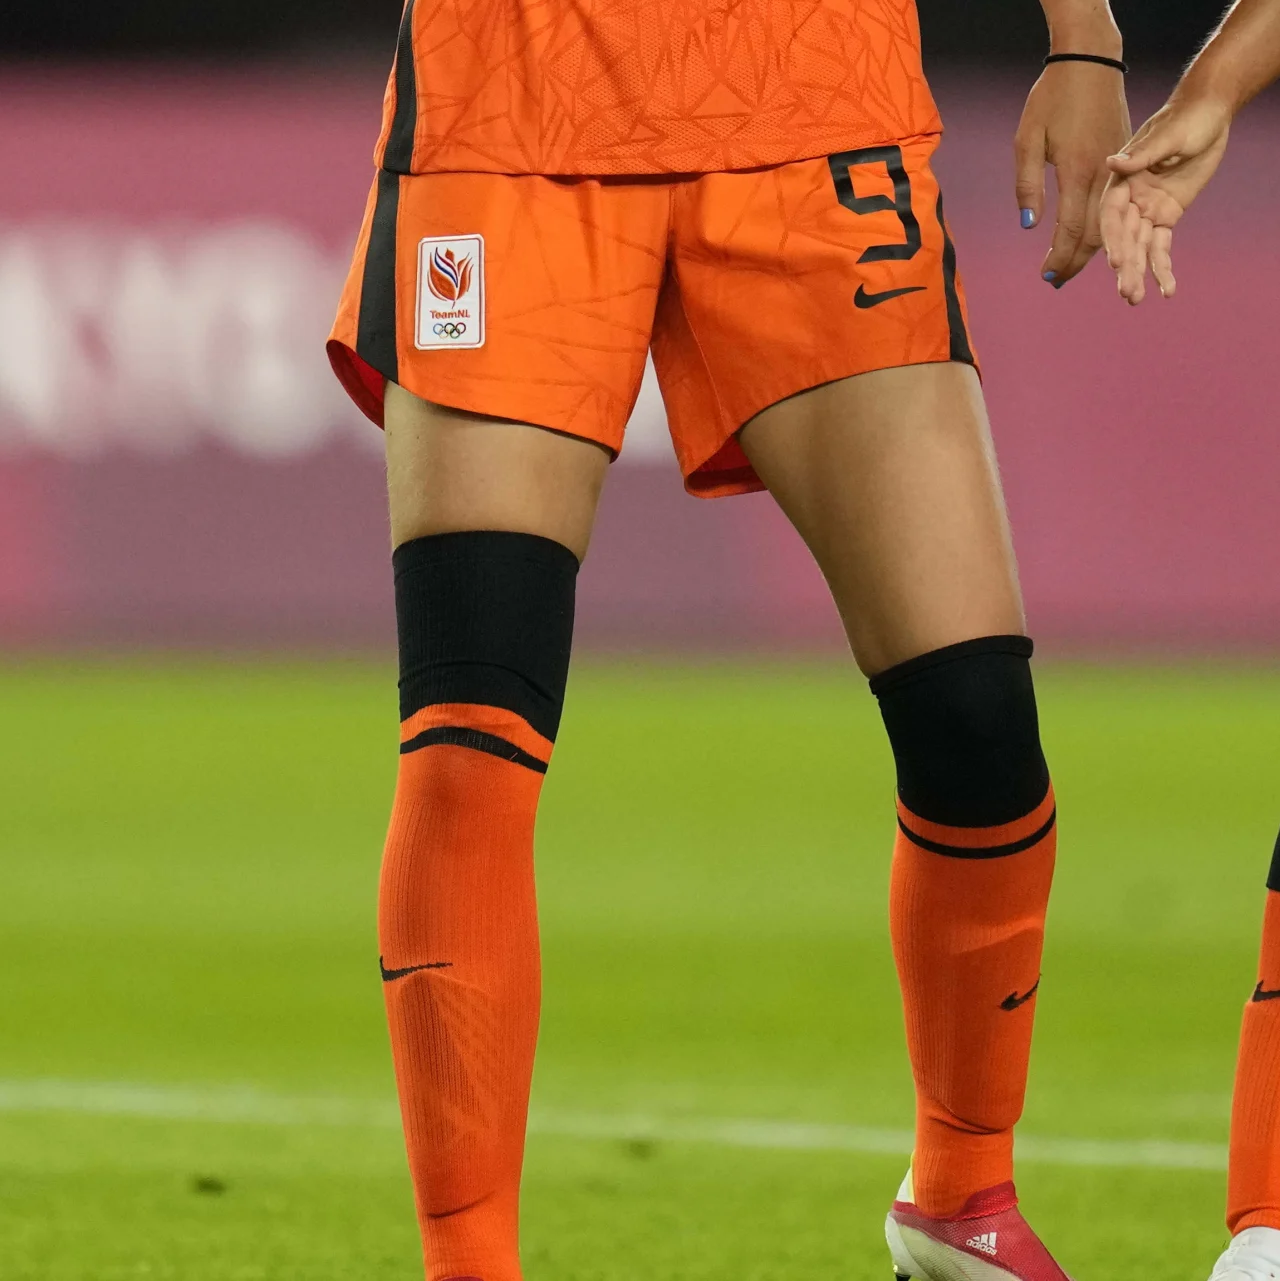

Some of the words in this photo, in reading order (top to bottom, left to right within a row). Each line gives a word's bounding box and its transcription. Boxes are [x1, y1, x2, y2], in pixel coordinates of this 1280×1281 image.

[827, 144, 923, 265] 9
[430, 310, 470, 319] TeamNL
[966, 1239, 997, 1255] adidas
